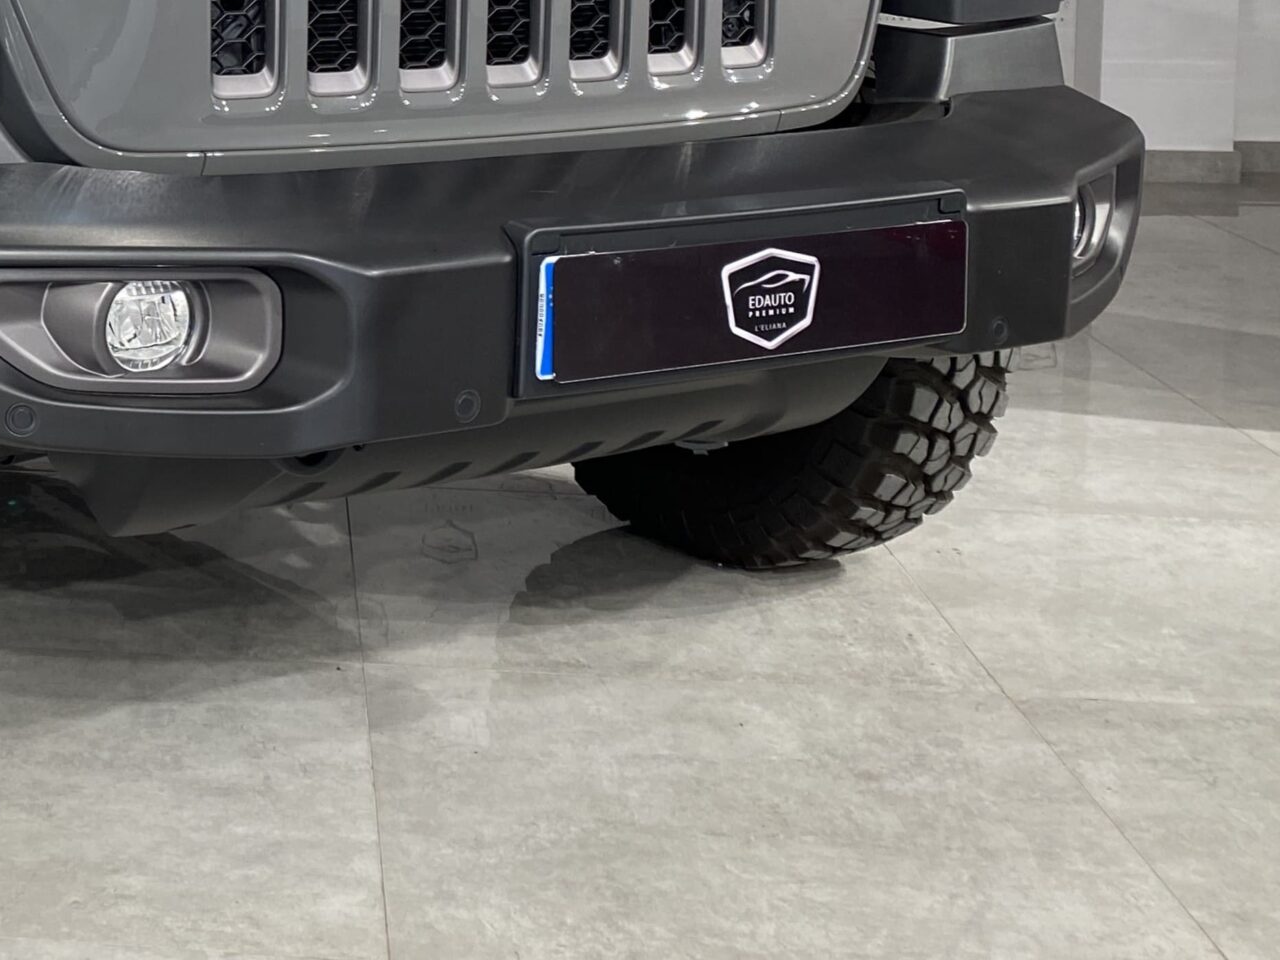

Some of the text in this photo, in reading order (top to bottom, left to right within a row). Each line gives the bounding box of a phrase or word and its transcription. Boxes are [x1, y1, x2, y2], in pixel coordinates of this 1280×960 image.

[748, 292, 795, 309] EDAUTO
[748, 307, 795, 318] PREMIUM
[754, 321, 787, 332] L'ELIANA
